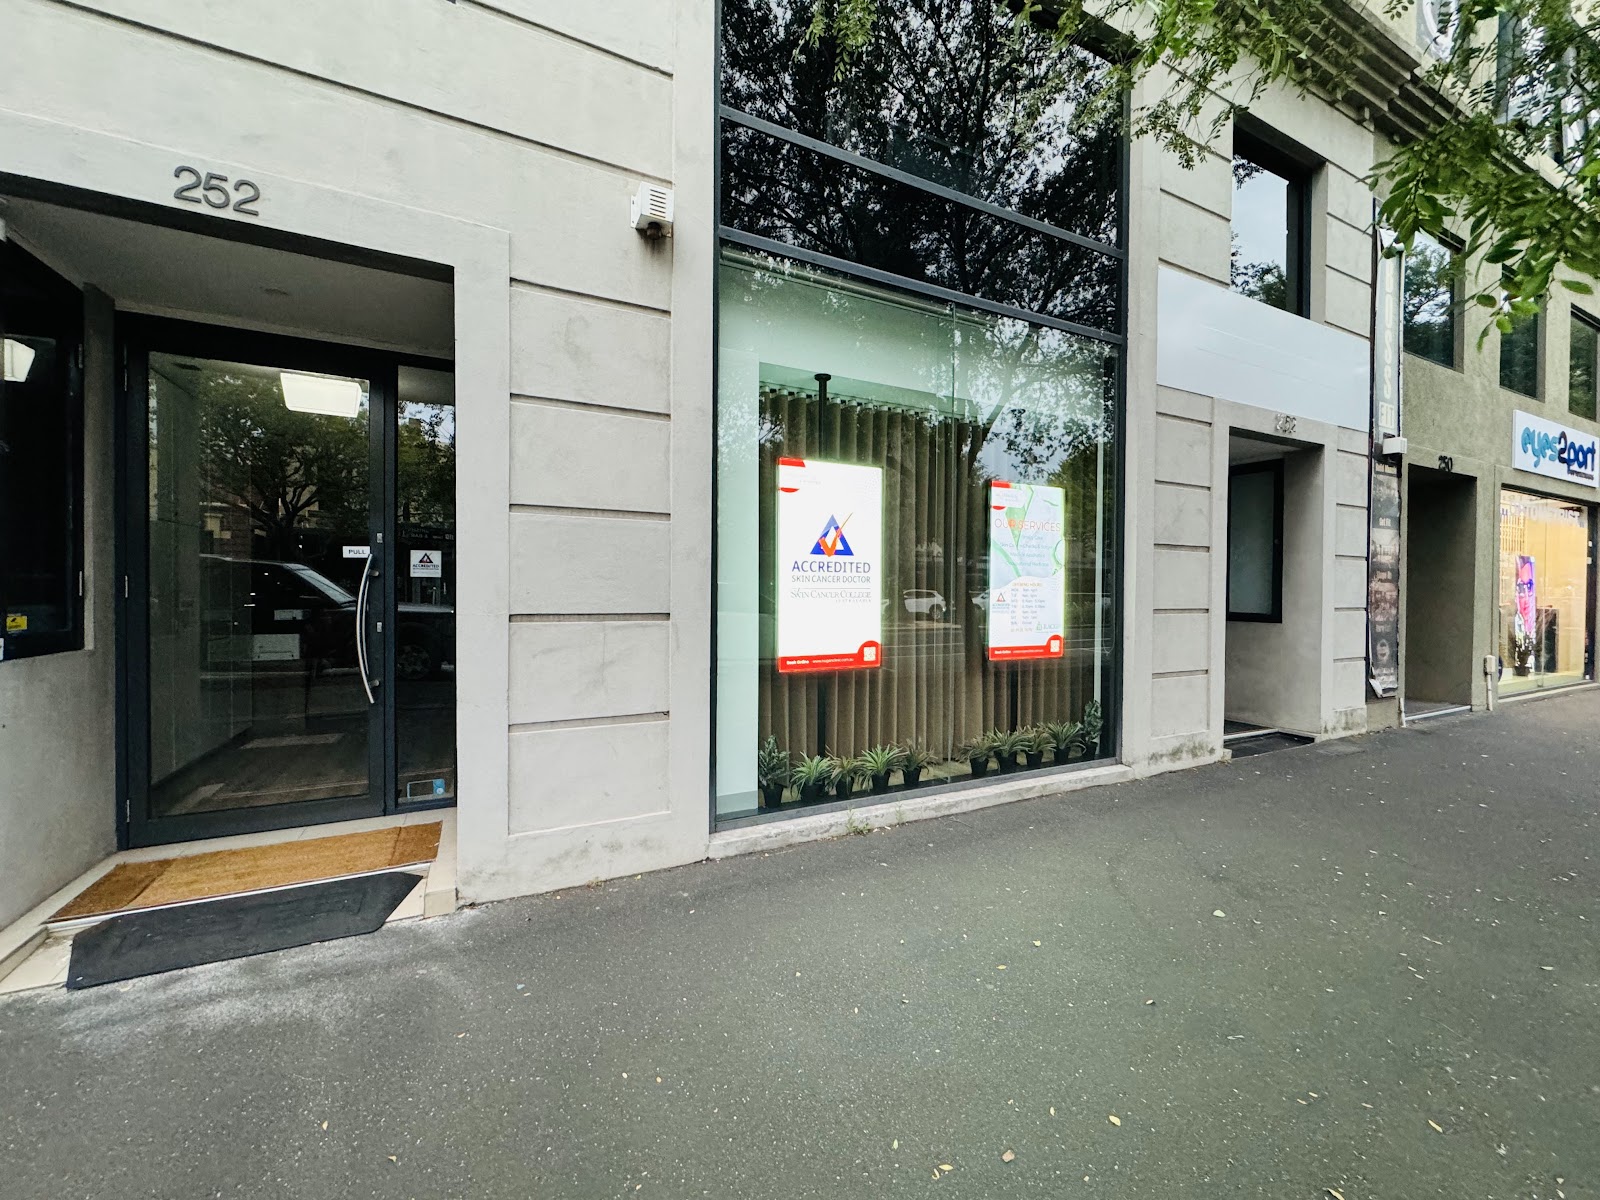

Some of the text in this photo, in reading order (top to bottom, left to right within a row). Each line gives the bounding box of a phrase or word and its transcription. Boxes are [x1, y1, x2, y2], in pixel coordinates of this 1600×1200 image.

[173, 165, 261, 217] 252
[1018, 520, 1061, 532] SERVICES
[791, 560, 871, 573] ACCREDITED
[791, 575, 871, 583] SKIN CANCER DOCTOR
